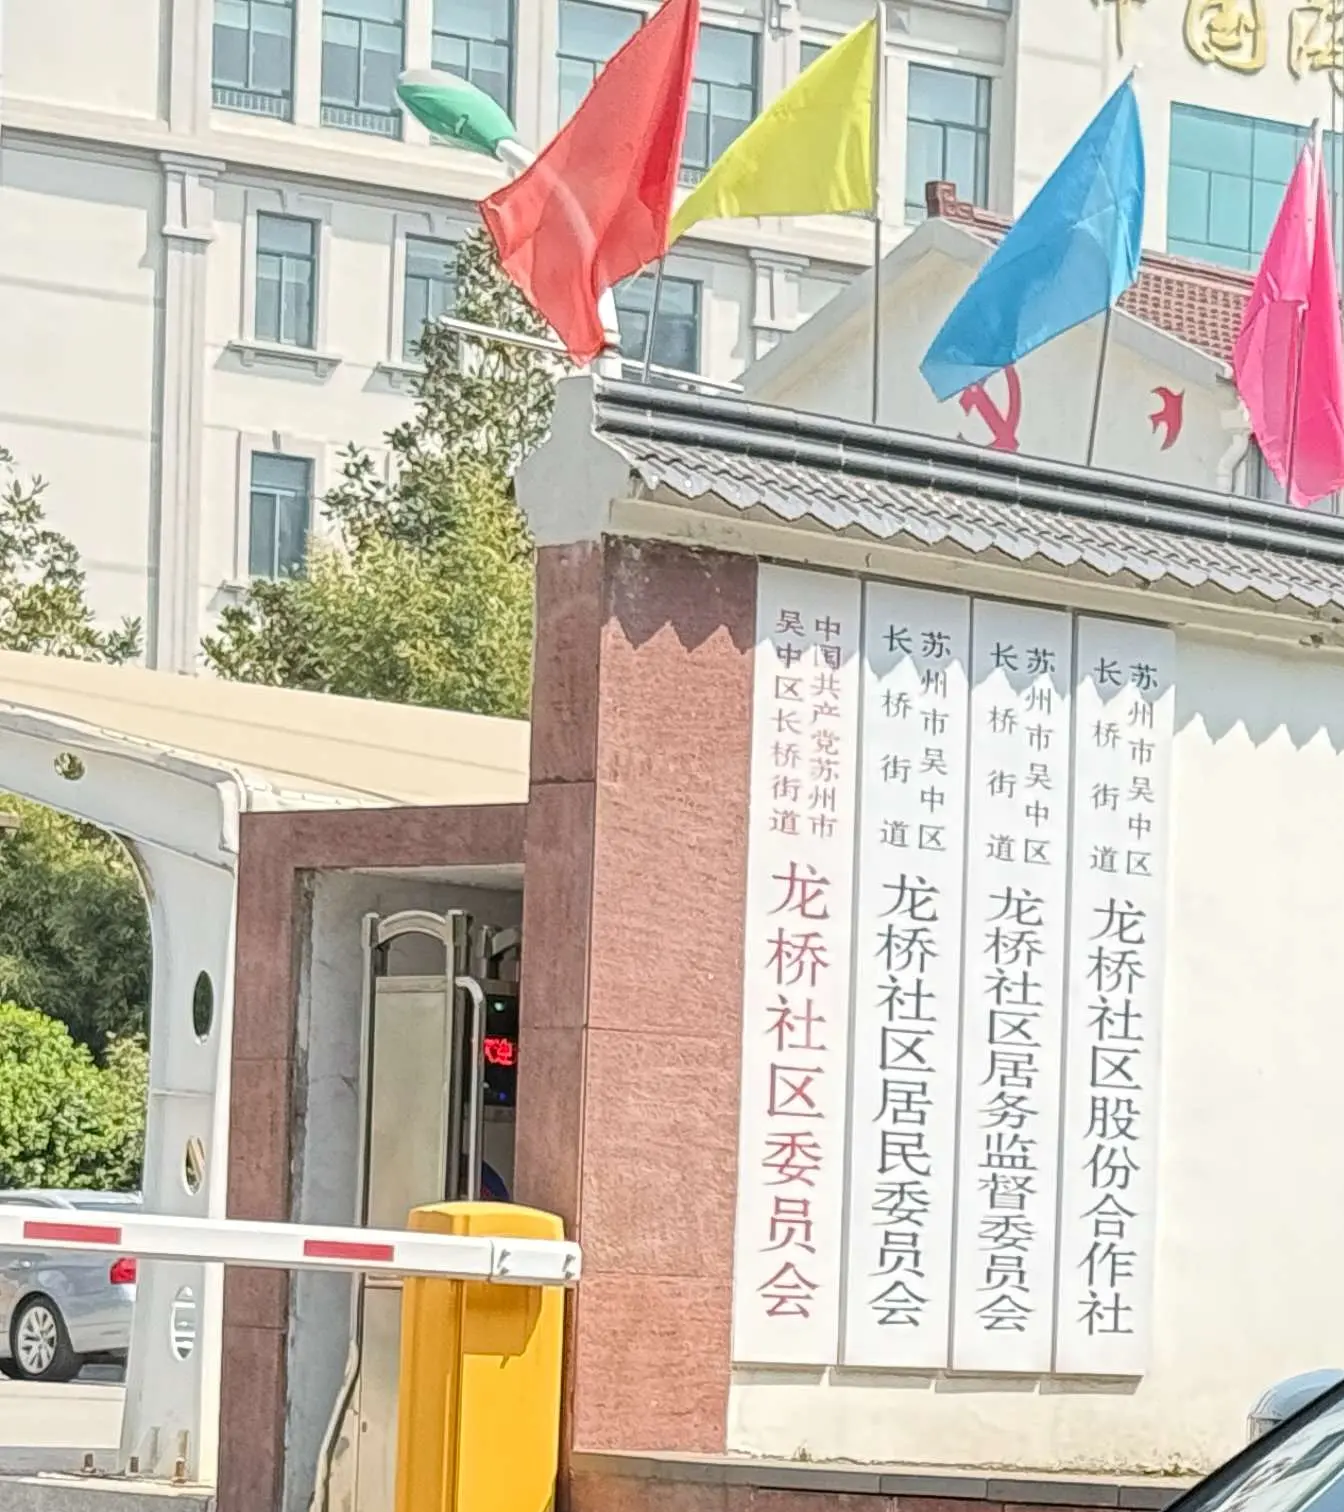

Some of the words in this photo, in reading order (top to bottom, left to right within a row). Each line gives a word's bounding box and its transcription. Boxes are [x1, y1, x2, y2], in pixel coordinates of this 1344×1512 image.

[768, 608, 806, 837] 吴中区长桥街道
[808, 615, 842, 840] 中国共产党苏州市
[879, 624, 914, 849] 长桥街道
[917, 631, 952, 853] 苏州市吴中区
[985, 642, 1020, 865] 长桥街道
[1023, 647, 1057, 867] 苏州市吴中区
[1089, 656, 1123, 876] 长桥街道
[1124, 662, 1160, 879] 苏州市吴中区
[756, 859, 831, 1319] 龙桥社区委员会
[867, 873, 942, 1328] 龙桥社区居民委员会
[974, 884, 1047, 1333] 龙桥社区居务监督委员会
[1076, 897, 1148, 1337] 龙桥社区股份合作社
